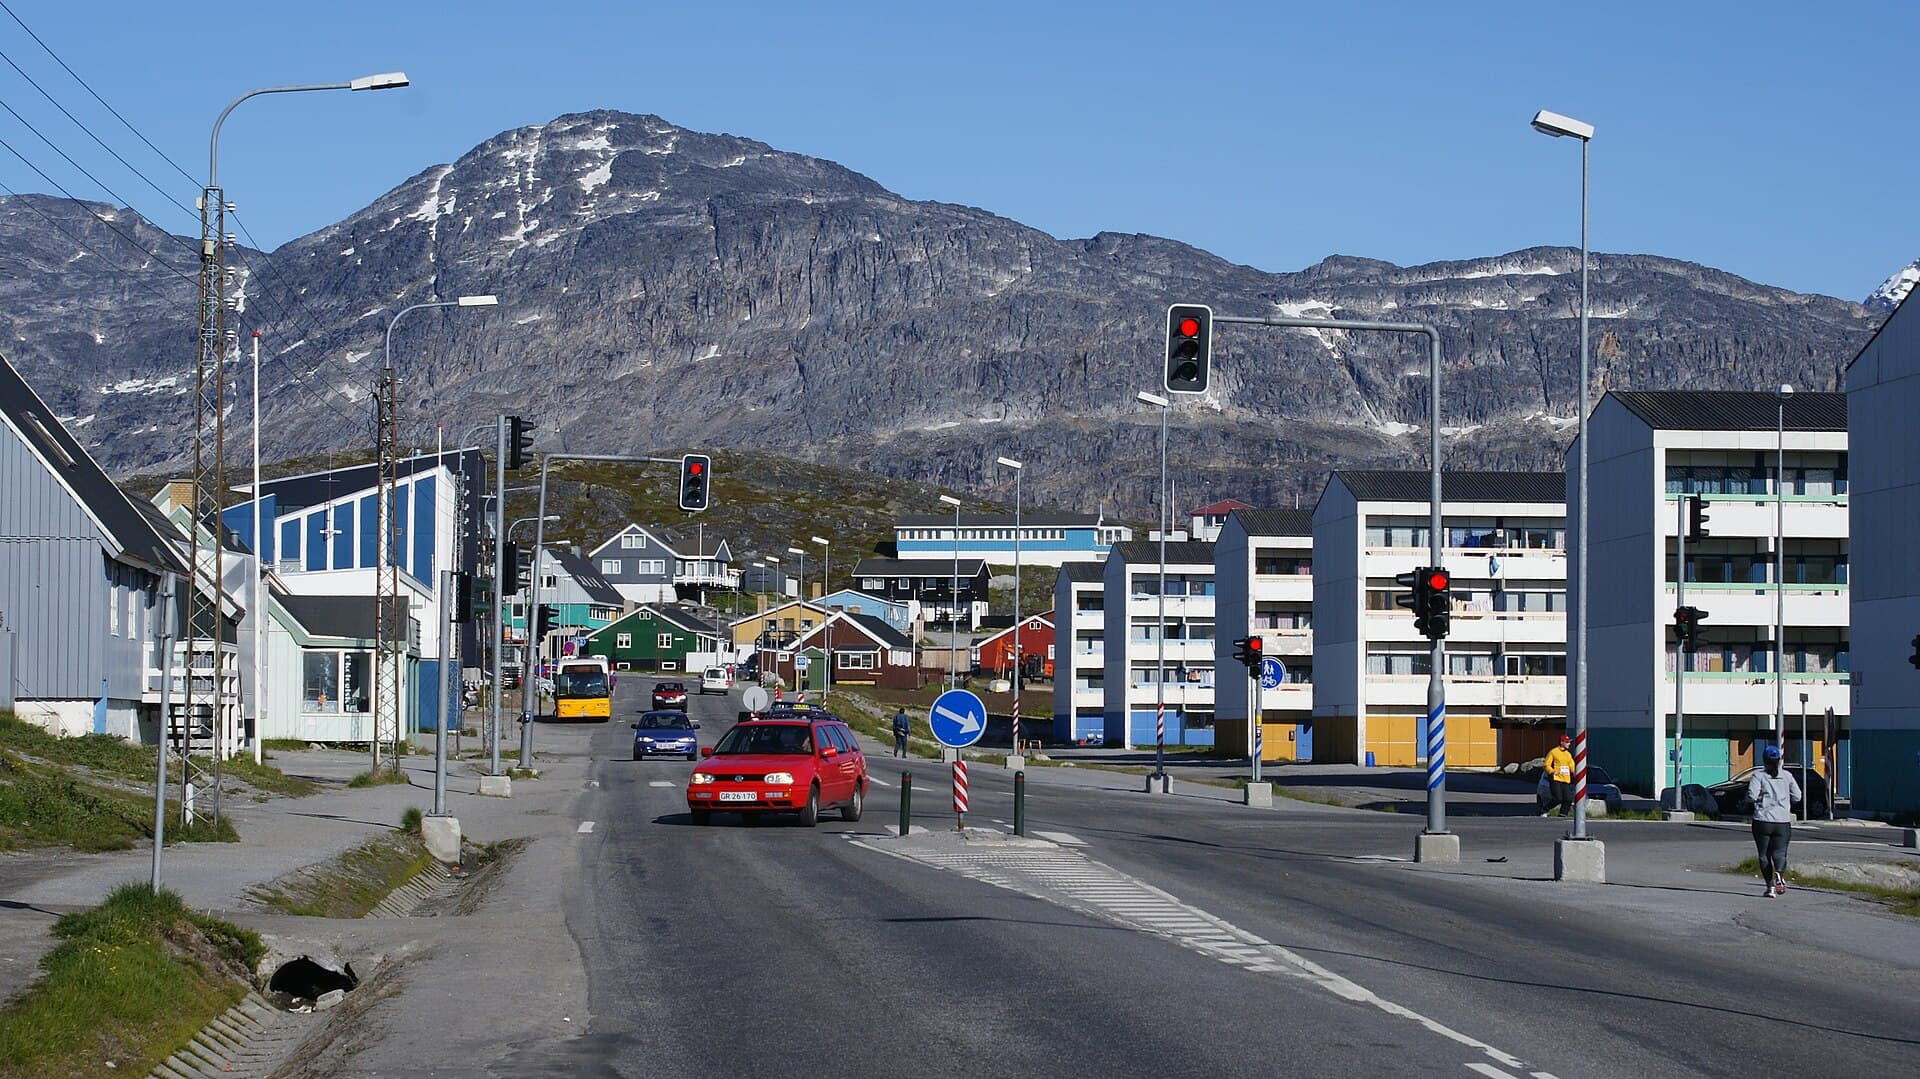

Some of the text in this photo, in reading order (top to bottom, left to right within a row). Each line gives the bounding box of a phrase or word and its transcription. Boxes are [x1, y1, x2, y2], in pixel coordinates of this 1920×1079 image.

[720, 792, 756, 800] GR 26 170
